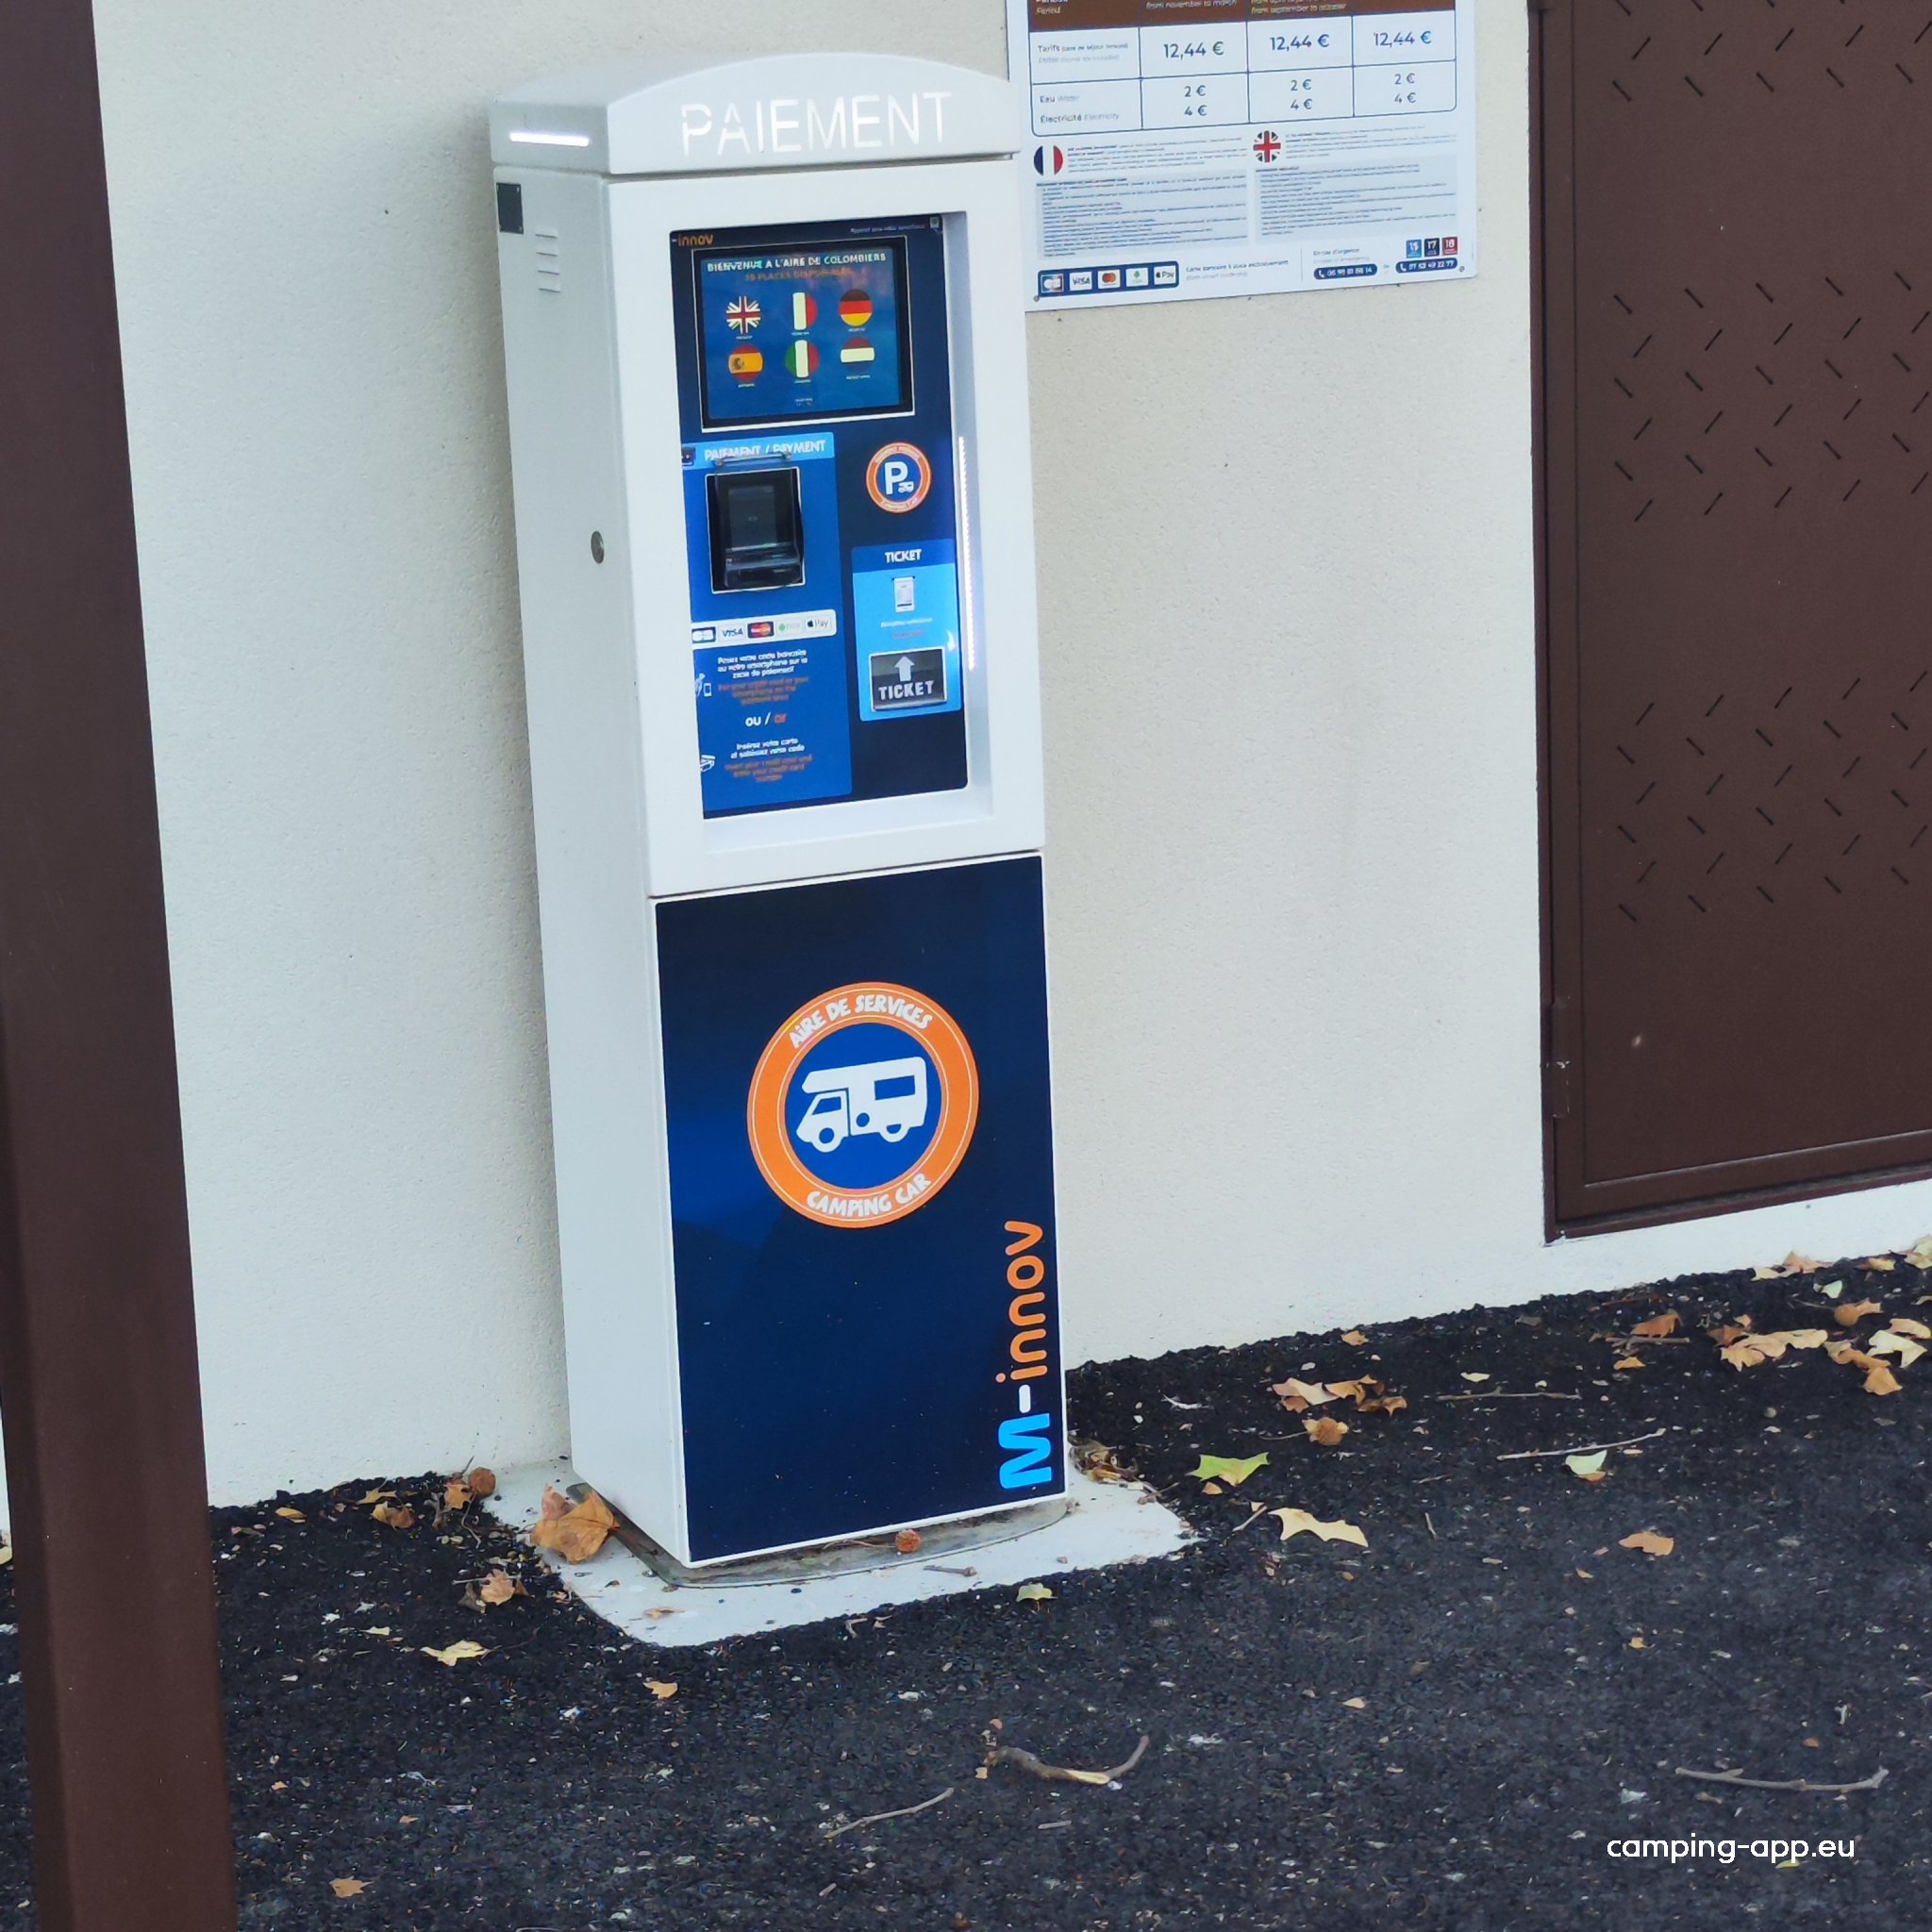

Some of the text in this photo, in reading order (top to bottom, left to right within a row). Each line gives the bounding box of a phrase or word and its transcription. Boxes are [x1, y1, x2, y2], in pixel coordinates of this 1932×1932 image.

[1269, 34, 1330, 52] 12,44 €
[1374, 30, 1432, 48] 12,44 €
[1163, 41, 1224, 60] 12,44 €
[1291, 78, 1312, 92] 2 €
[1394, 73, 1416, 85] 2 €
[1184, 84, 1207, 98] 2 €
[1394, 92, 1417, 104] 4 €
[1184, 105, 1208, 116] 4 €
[1290, 98, 1313, 110] 4 €
[681, 92, 953, 157] PAIEMENT
[1427, 241, 1437, 249] 17
[708, 259, 762, 273] BIENVENUE
[765, 259, 773, 269] A
[885, 548, 922, 563] TICKET
[878, 680, 935, 701] TICKET
[824, 998, 851, 1021] DE
[855, 994, 933, 1029] SERVICES
[807, 1173, 931, 1217] CAMPING CAR
[995, 1220, 1053, 1489] M-innov
